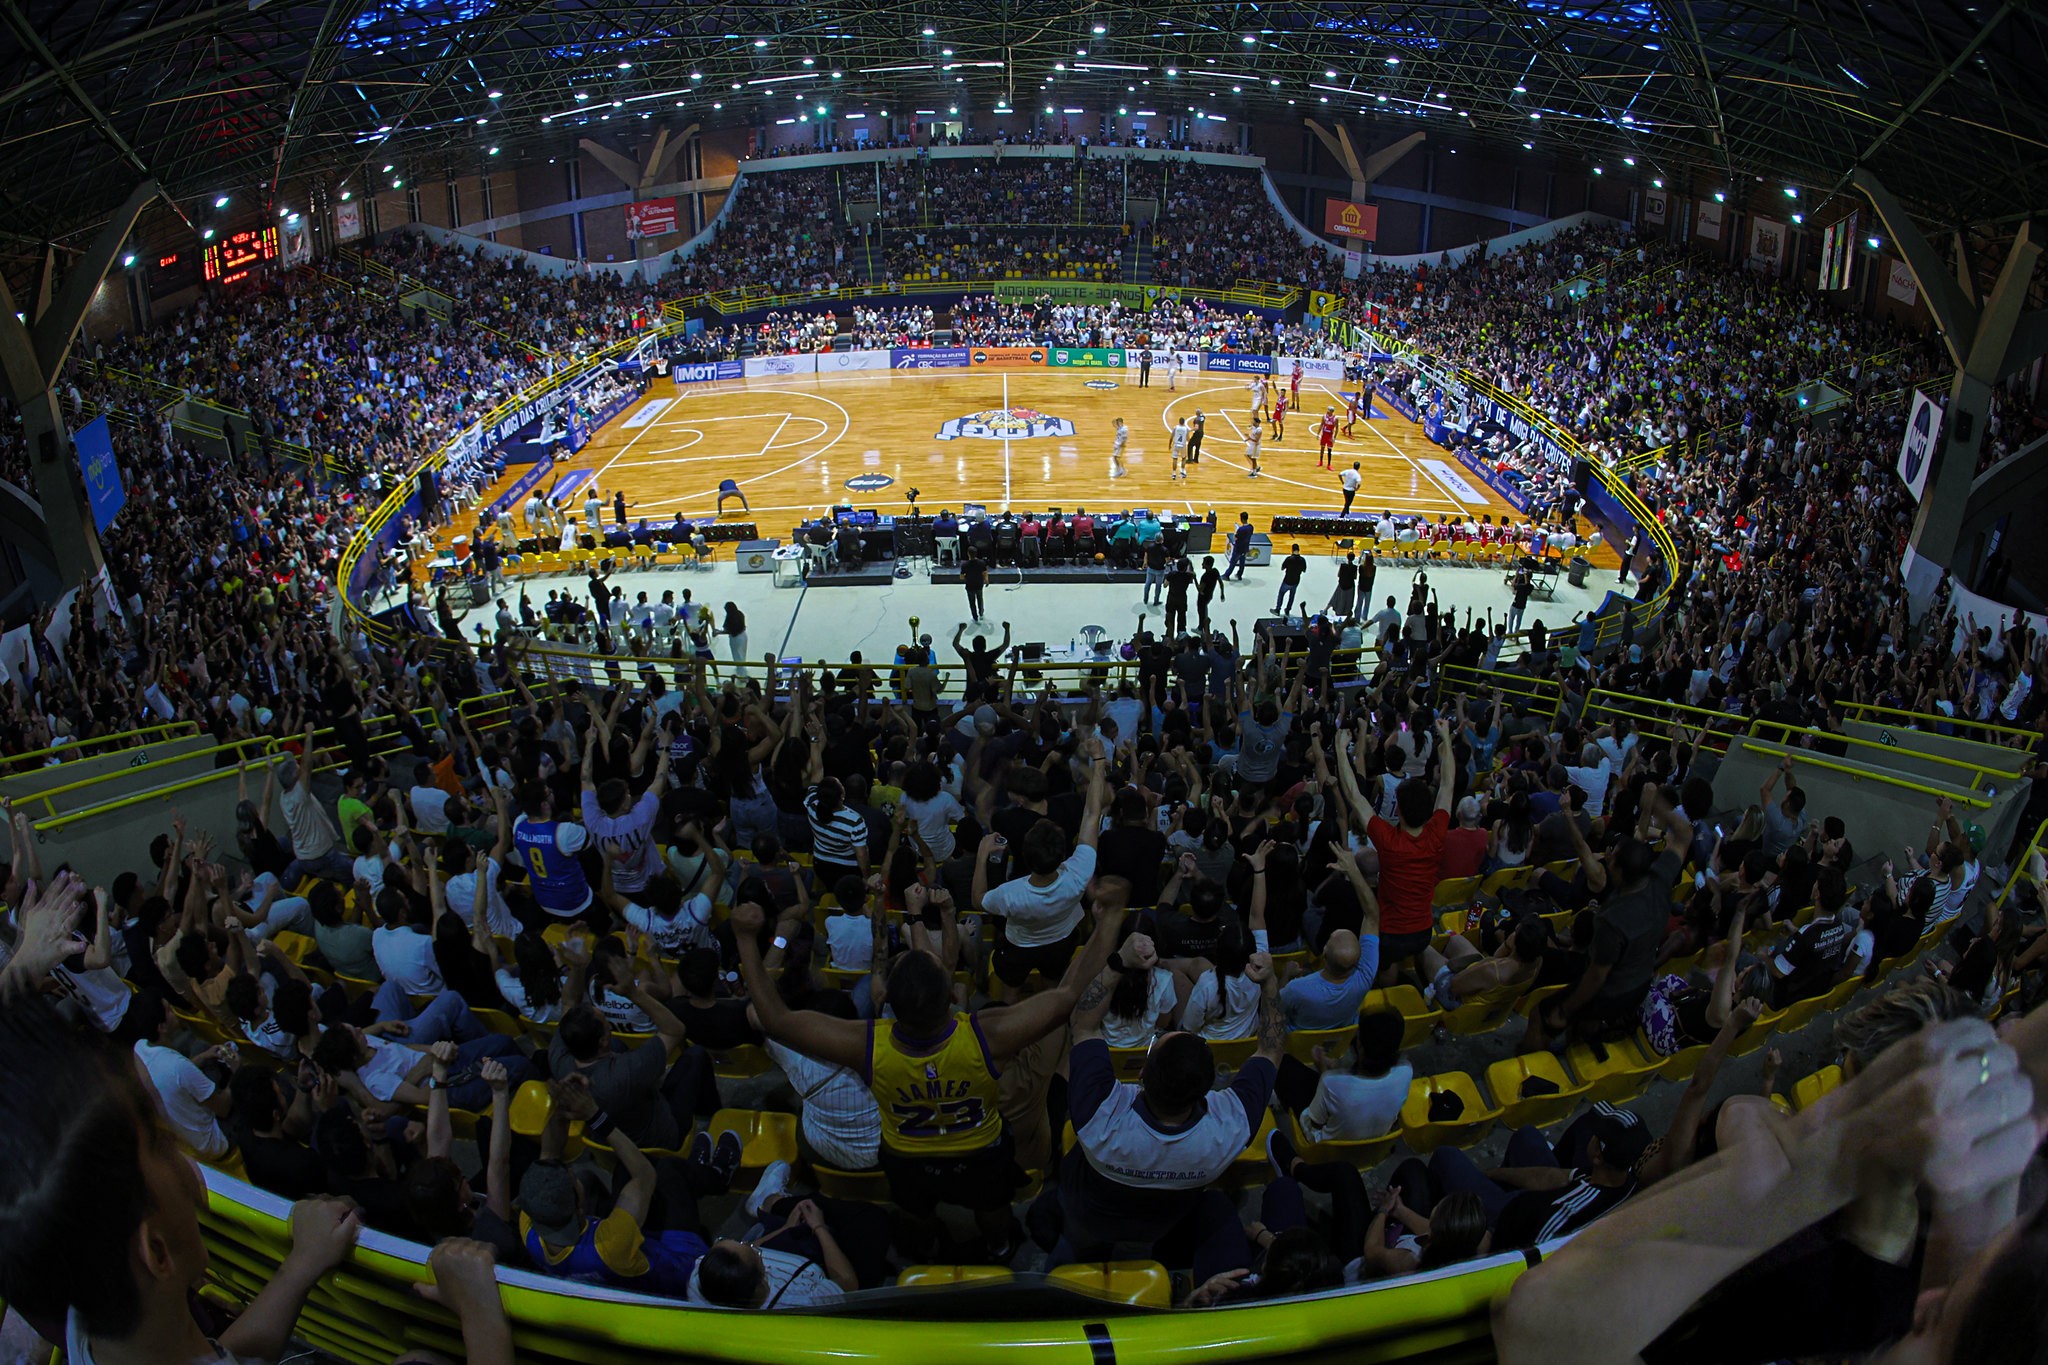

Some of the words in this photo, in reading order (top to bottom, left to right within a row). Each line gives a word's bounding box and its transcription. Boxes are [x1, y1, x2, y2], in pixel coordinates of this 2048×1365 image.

[999, 286, 1025, 299] MOGI
[1027, 287, 1087, 299] BASQUETE
[1111, 290, 1141, 301] ANOS
[1238, 360, 1270, 370] necton
[529, 847, 547, 878] 8
[896, 1080, 971, 1103] JAMES
[891, 1097, 986, 1136] 23
